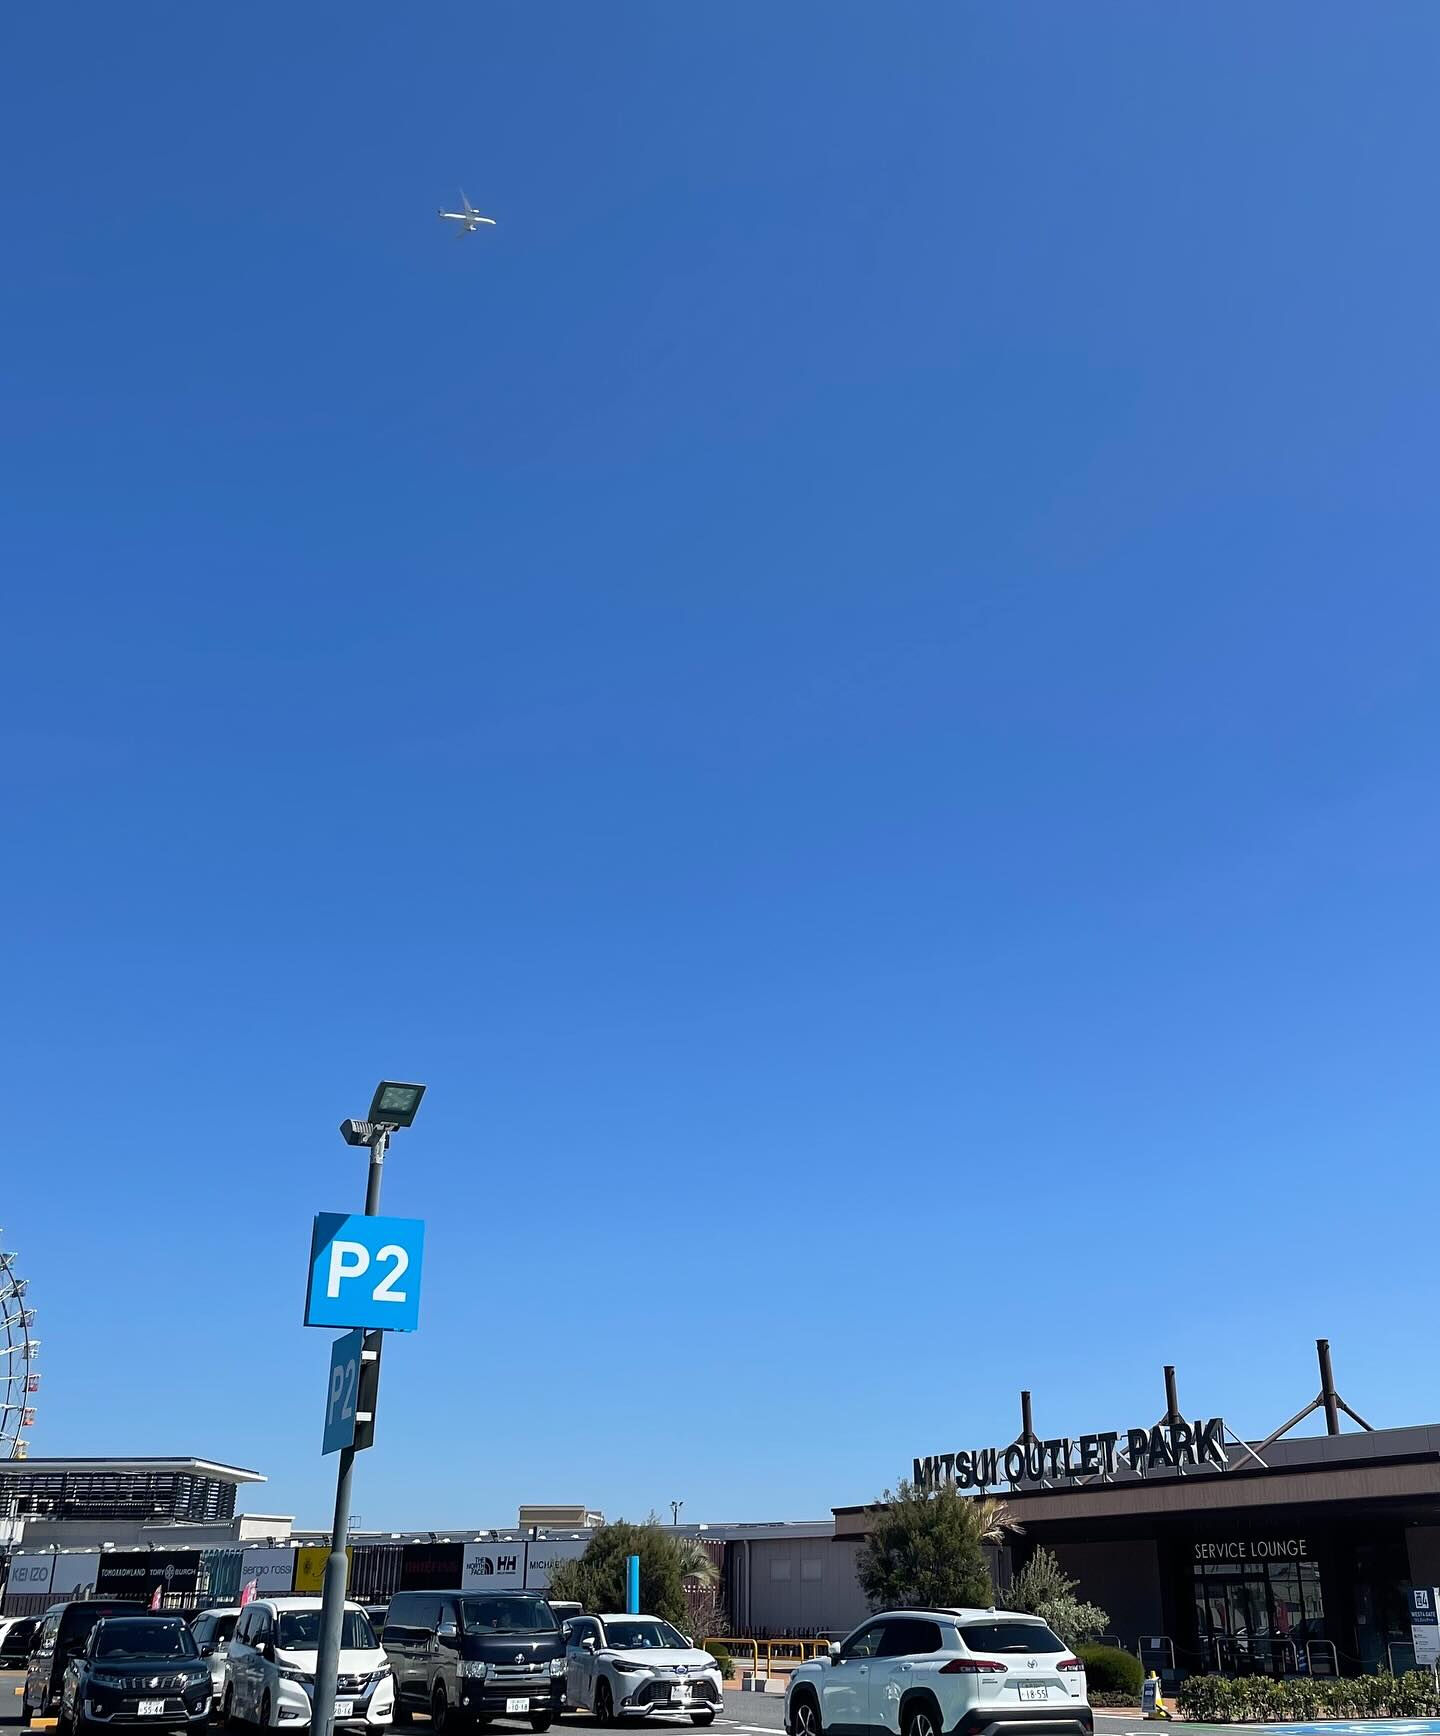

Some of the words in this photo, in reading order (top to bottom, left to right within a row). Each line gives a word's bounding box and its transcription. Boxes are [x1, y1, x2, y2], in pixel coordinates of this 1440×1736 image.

[326, 1240, 409, 1303] P2
[328, 1359, 356, 1425] P2
[913, 1448, 1000, 1490] MITSUI
[1004, 1431, 1119, 1484] OUTLET
[1127, 1418, 1228, 1470] PARK
[1194, 1542, 1247, 1559] SERVICE
[1250, 1539, 1308, 1557] LOUNGE
[11, 1566, 49, 1582] KENZO
[149, 1568, 165, 1576] TORY
[174, 1568, 197, 1576] BURCH
